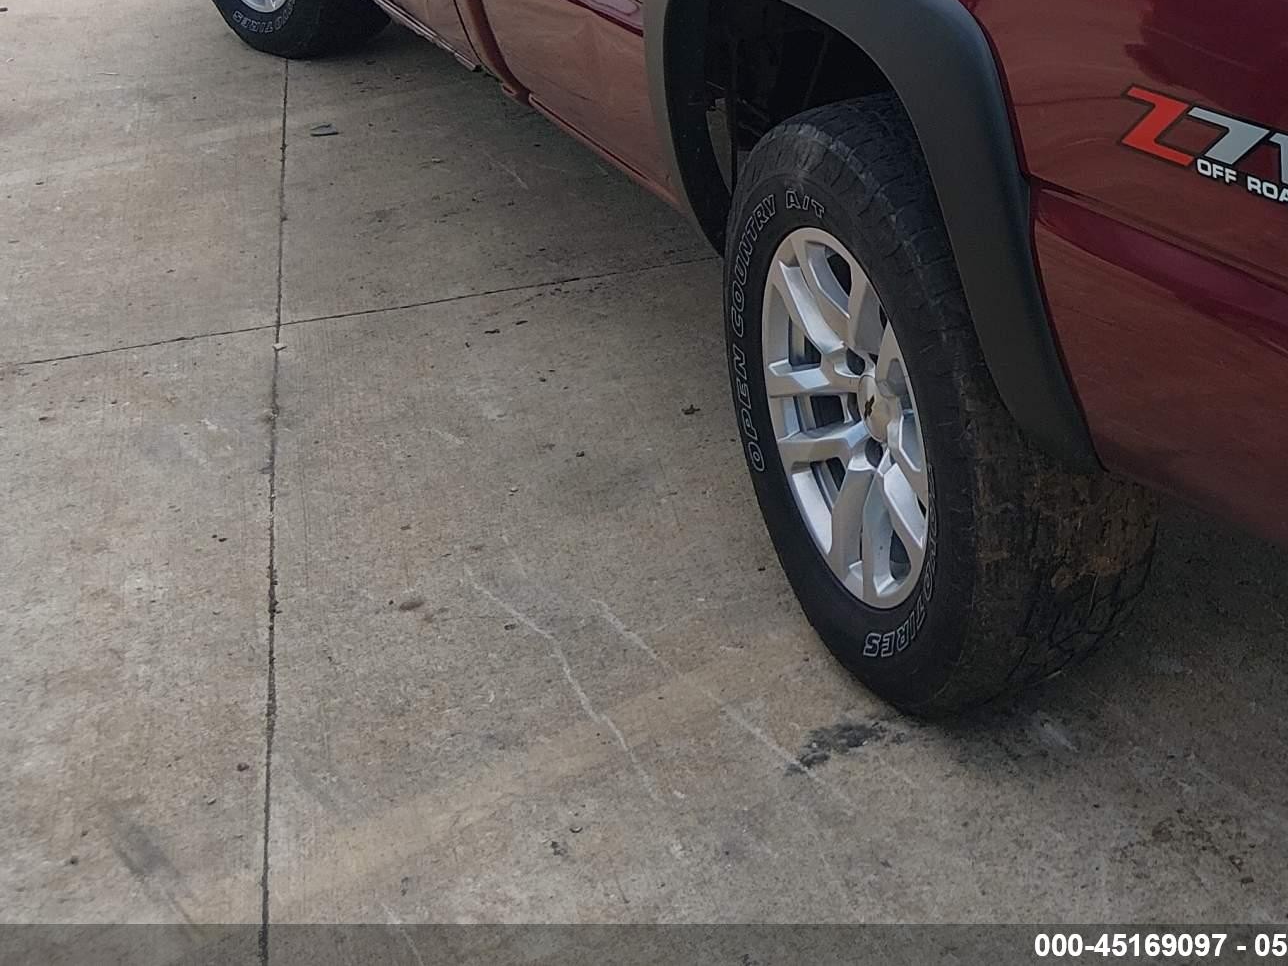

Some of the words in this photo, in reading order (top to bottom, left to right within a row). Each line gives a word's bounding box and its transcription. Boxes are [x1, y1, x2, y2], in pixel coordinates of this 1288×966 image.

[1196, 157, 1237, 184] OFF
[731, 193, 777, 338] COUNTRY
[732, 343, 765, 472] OPEN
[863, 594, 926, 657] TIRES
